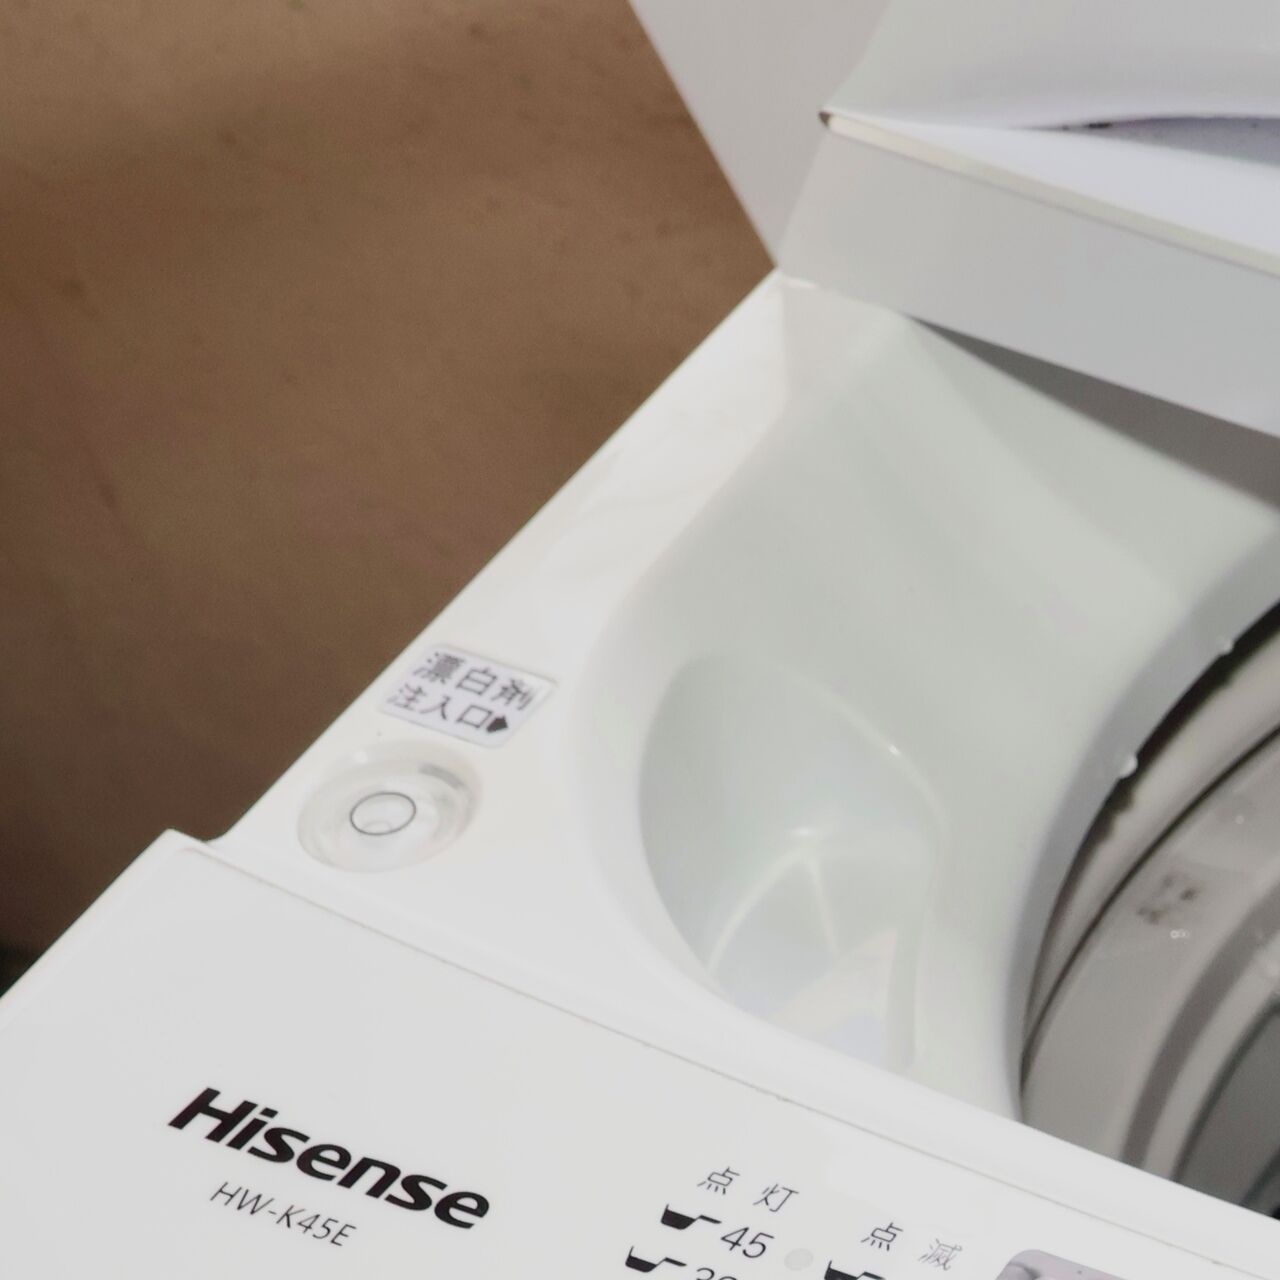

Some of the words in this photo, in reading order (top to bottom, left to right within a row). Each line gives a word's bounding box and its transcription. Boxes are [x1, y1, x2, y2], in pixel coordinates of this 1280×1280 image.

[386, 683, 494, 729] 注入口
[412, 651, 535, 711] 漂白剤
[167, 1086, 491, 1230] Hisense
[209, 1181, 358, 1247] HW-K45E
[719, 1226, 775, 1259] 45
